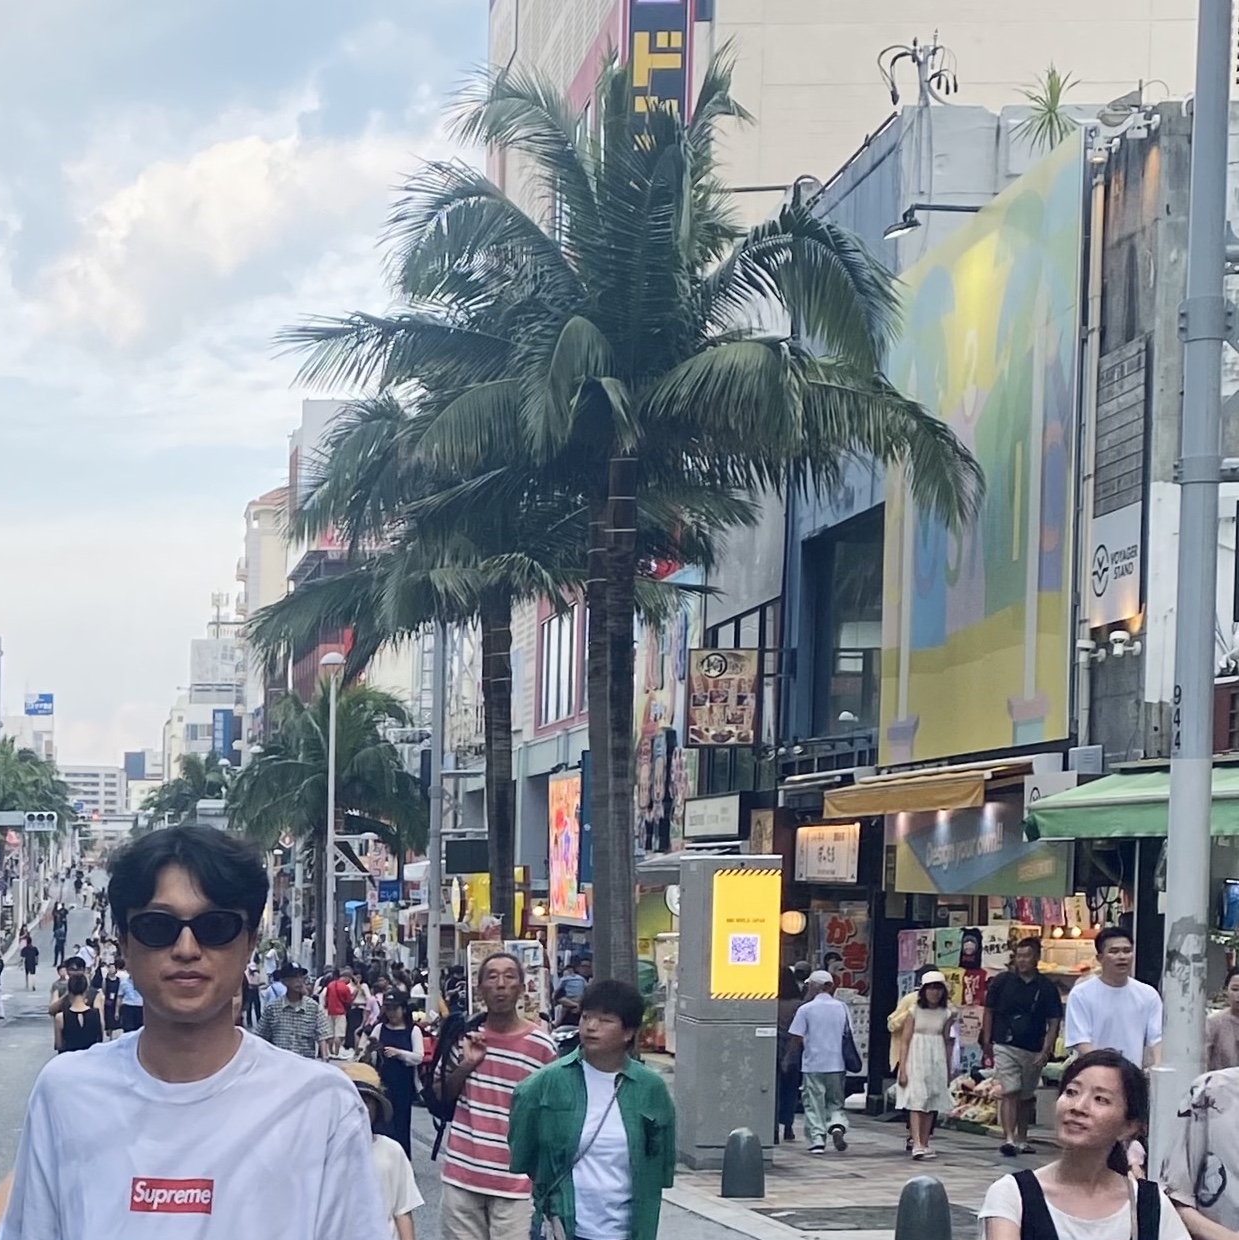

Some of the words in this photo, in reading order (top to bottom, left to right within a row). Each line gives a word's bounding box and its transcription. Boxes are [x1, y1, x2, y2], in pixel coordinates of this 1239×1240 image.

[1110, 544, 1138, 565] VOYAGER
[1113, 561, 1134, 580] STAND
[1173, 685, 1182, 750] 944
[133, 1181, 211, 1210] Supreme
